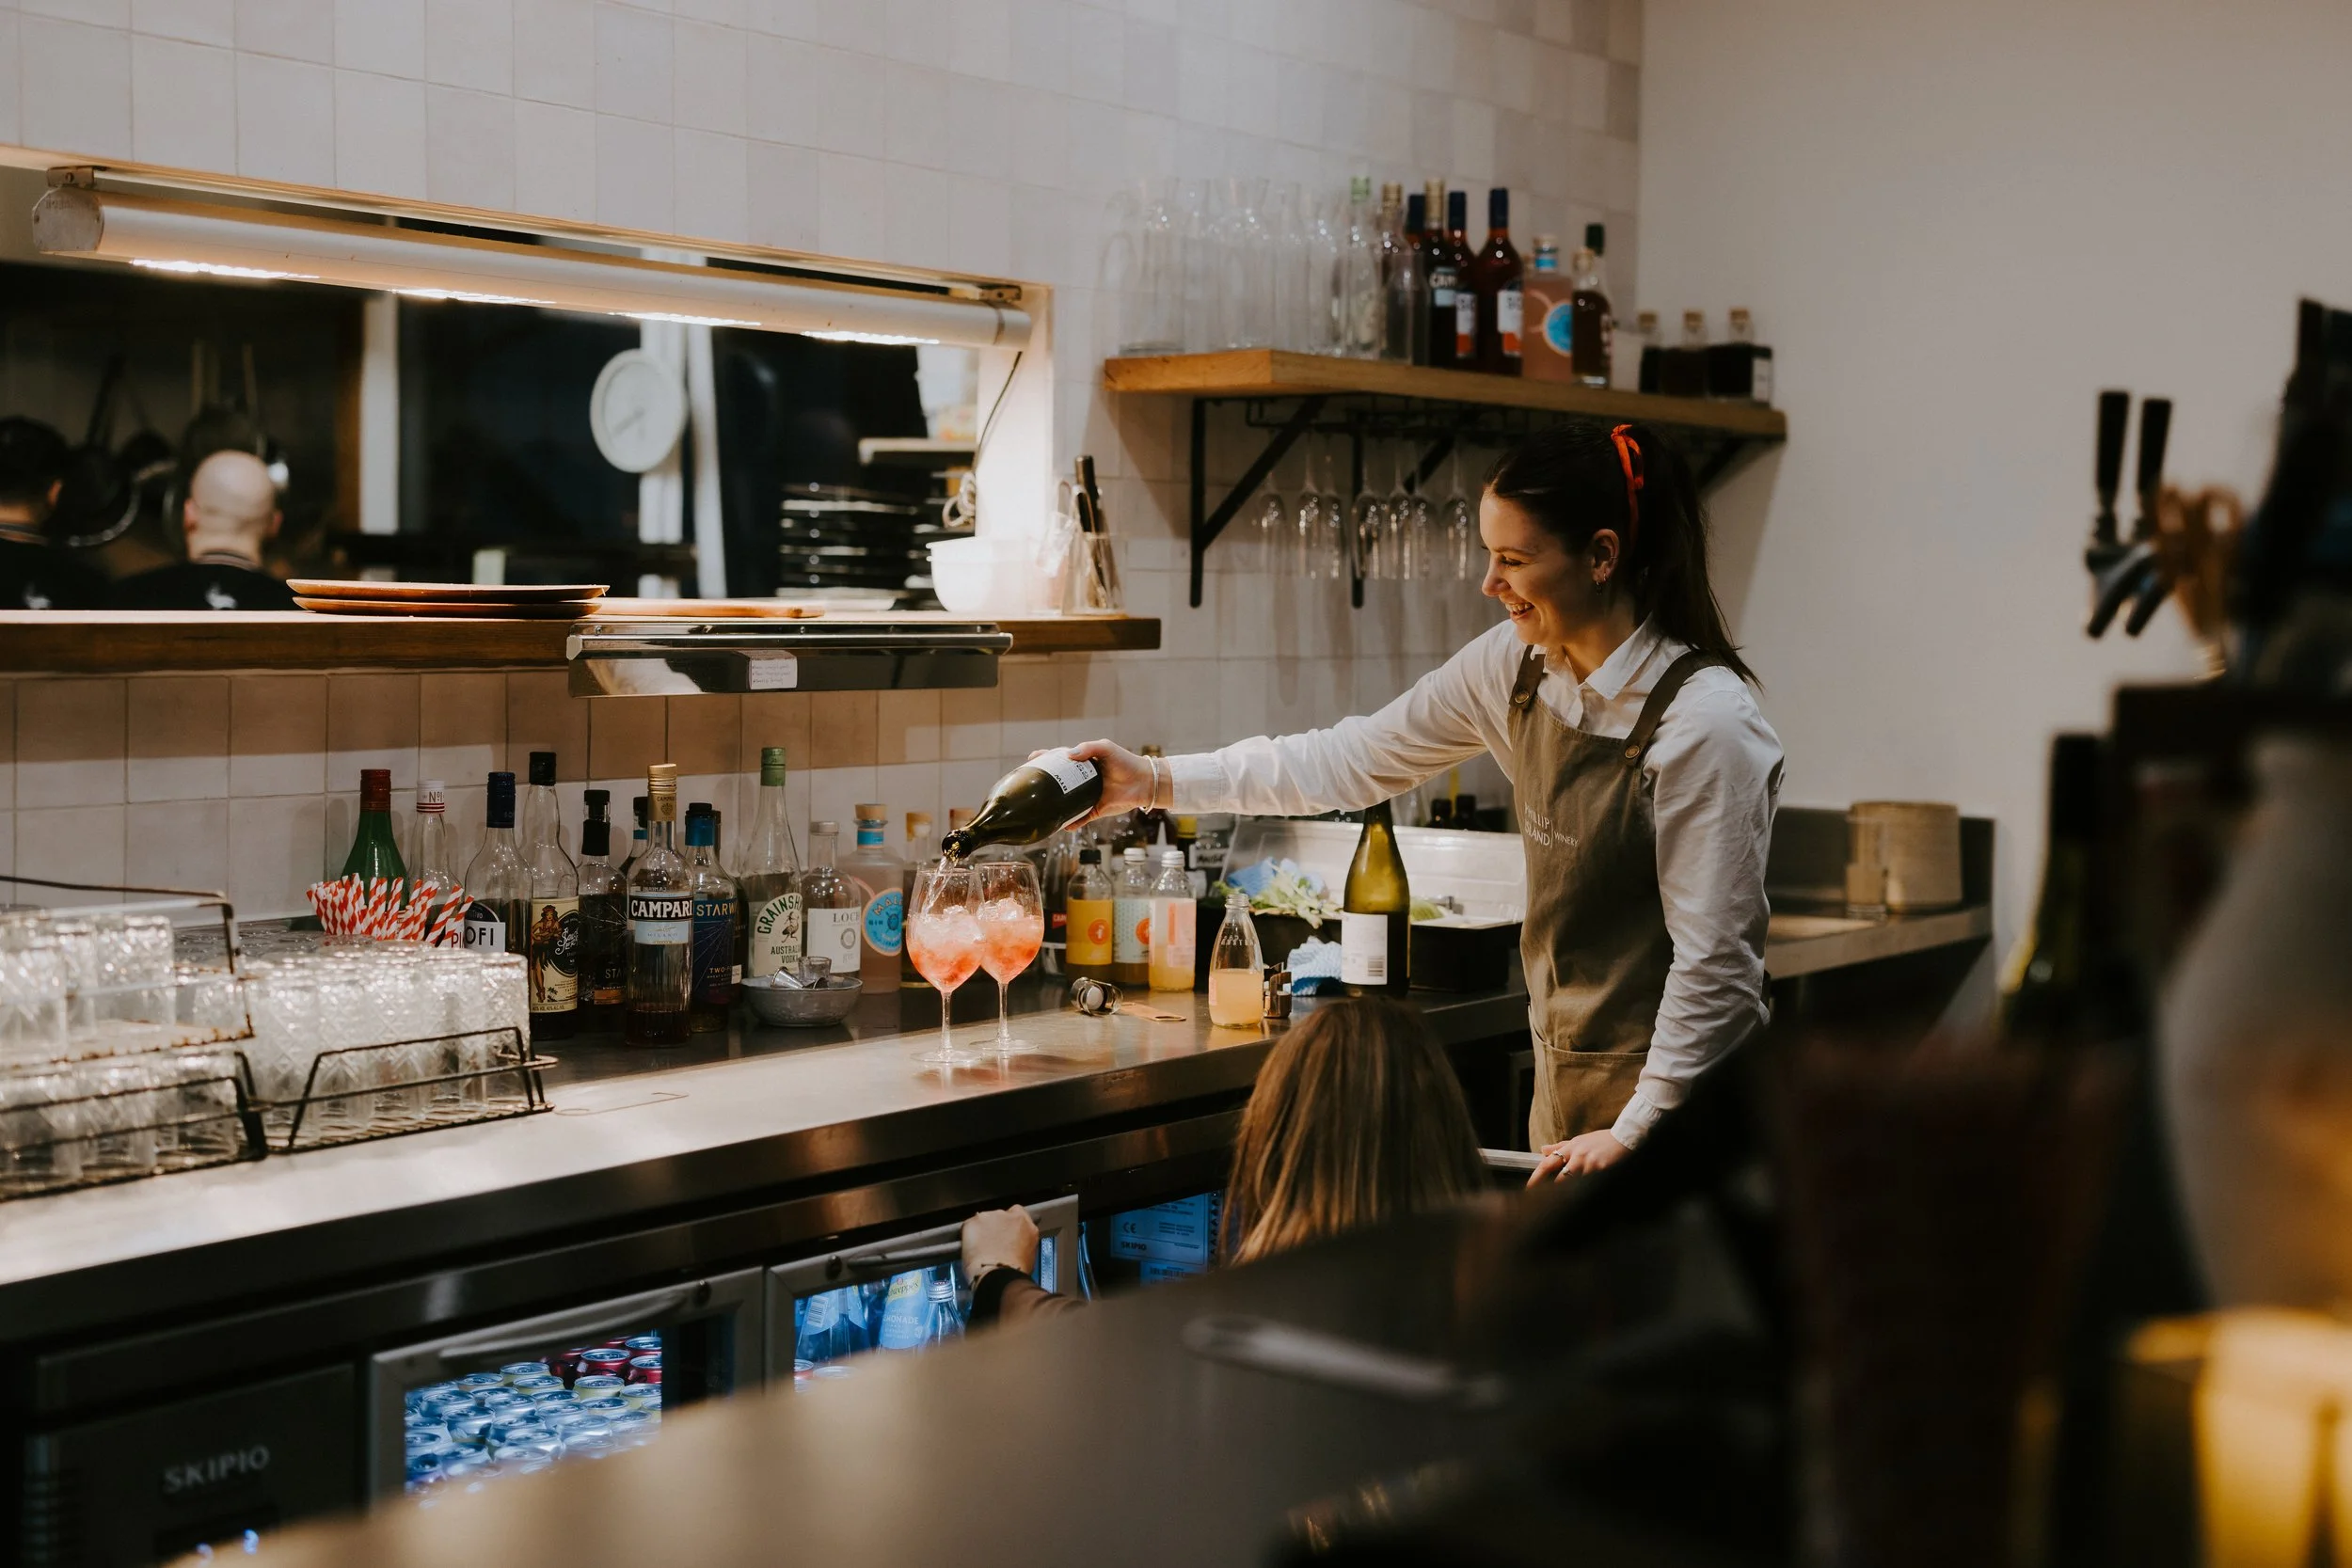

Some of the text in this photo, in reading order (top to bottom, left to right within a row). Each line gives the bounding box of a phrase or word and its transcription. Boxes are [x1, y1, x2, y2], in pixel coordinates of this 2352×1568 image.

[1525, 801, 1550, 830] PHILLIP
[1554, 831, 1579, 847] WINERY
[631, 900, 692, 918] CAMPARI
[696, 902, 738, 917] STARW
[465, 926, 494, 946] OFI
[164, 1446, 270, 1494] SKIPIO
